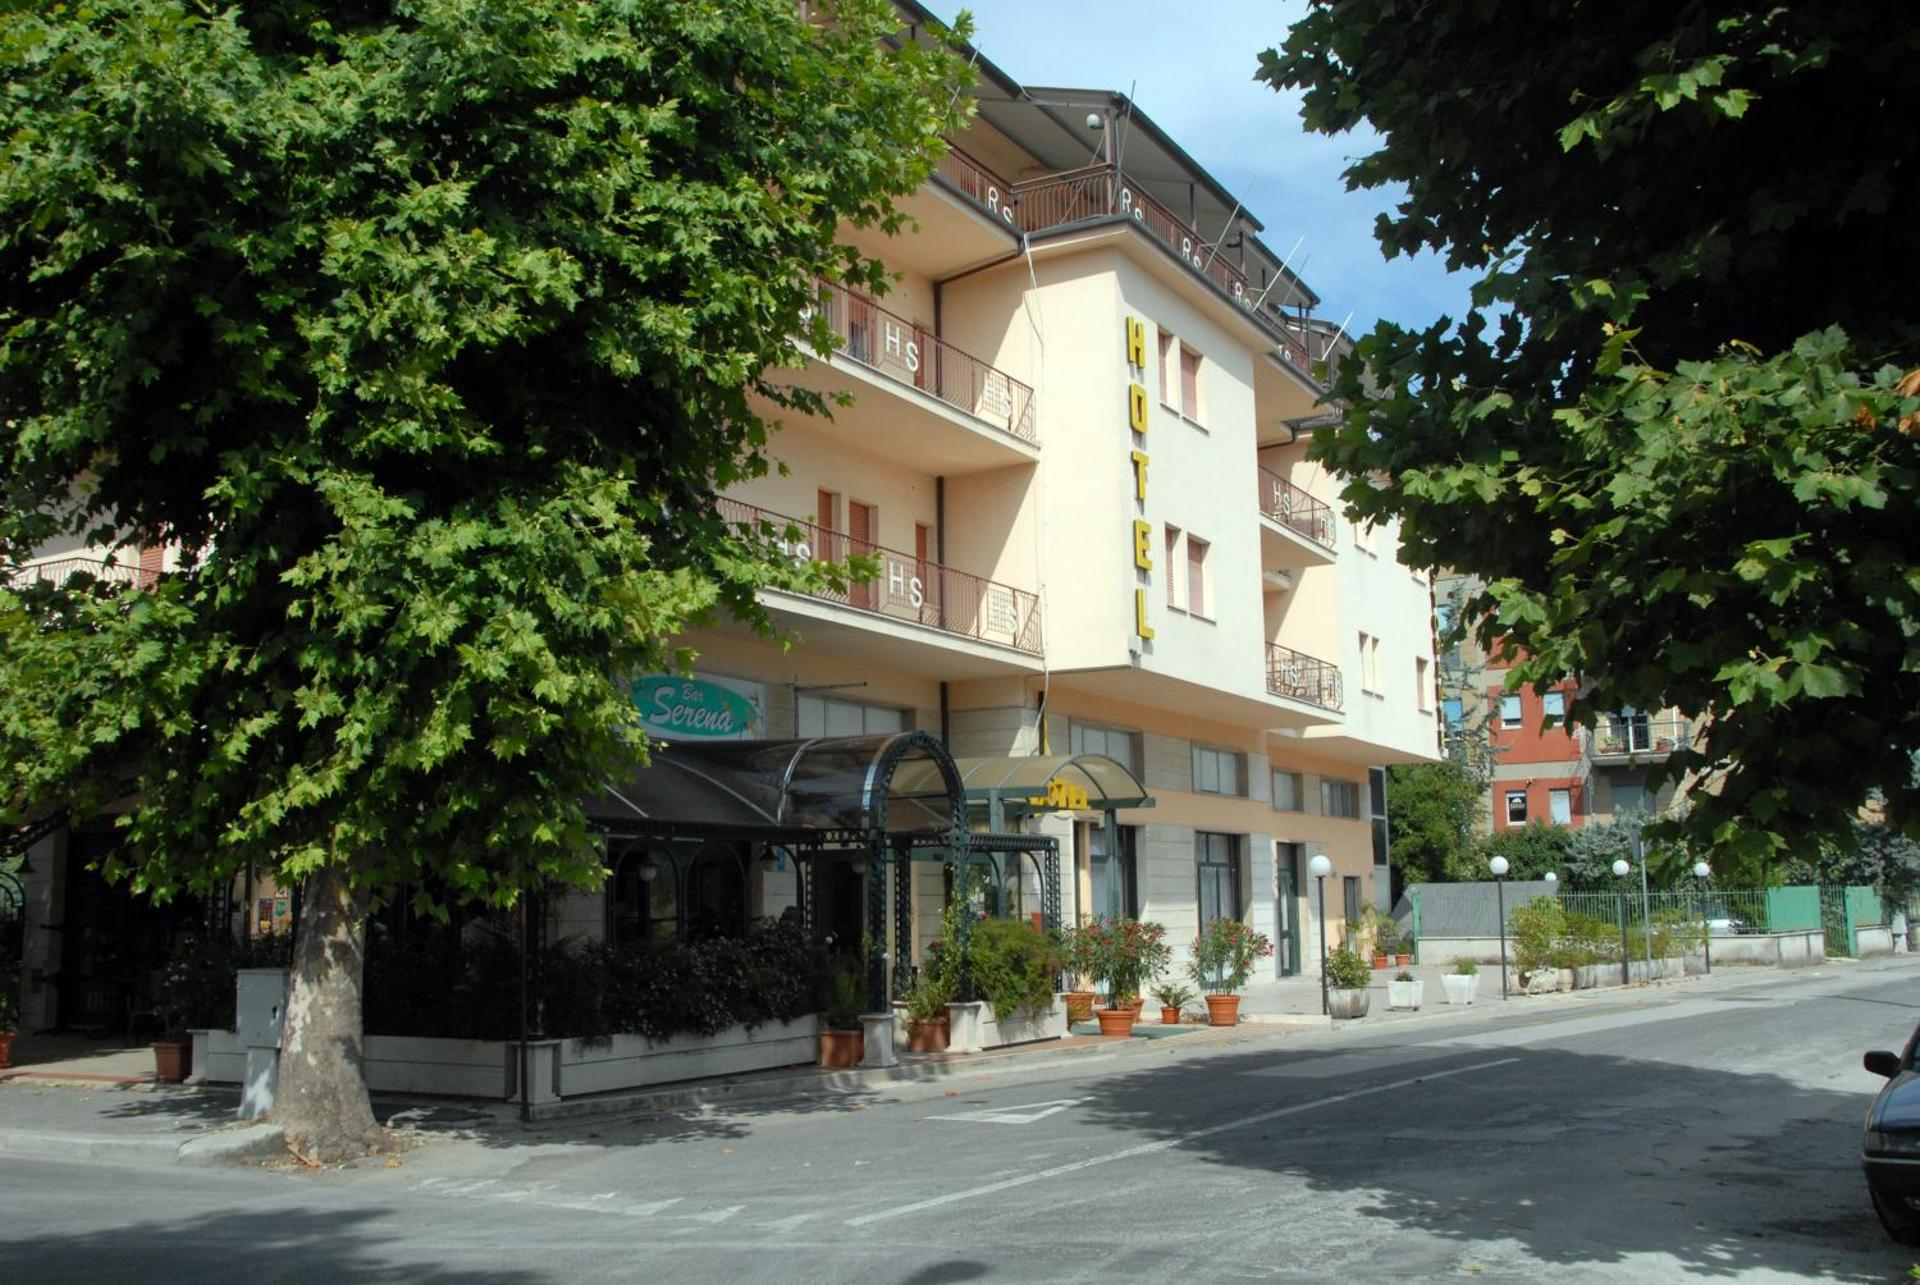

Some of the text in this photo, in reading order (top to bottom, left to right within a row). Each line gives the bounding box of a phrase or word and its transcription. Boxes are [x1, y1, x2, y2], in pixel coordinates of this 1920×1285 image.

[886, 321, 919, 372] HS
[1126, 316, 1155, 640] HOTEL
[889, 561, 923, 608] HS
[650, 685, 734, 733] Serena
[682, 682, 704, 702] Bar
